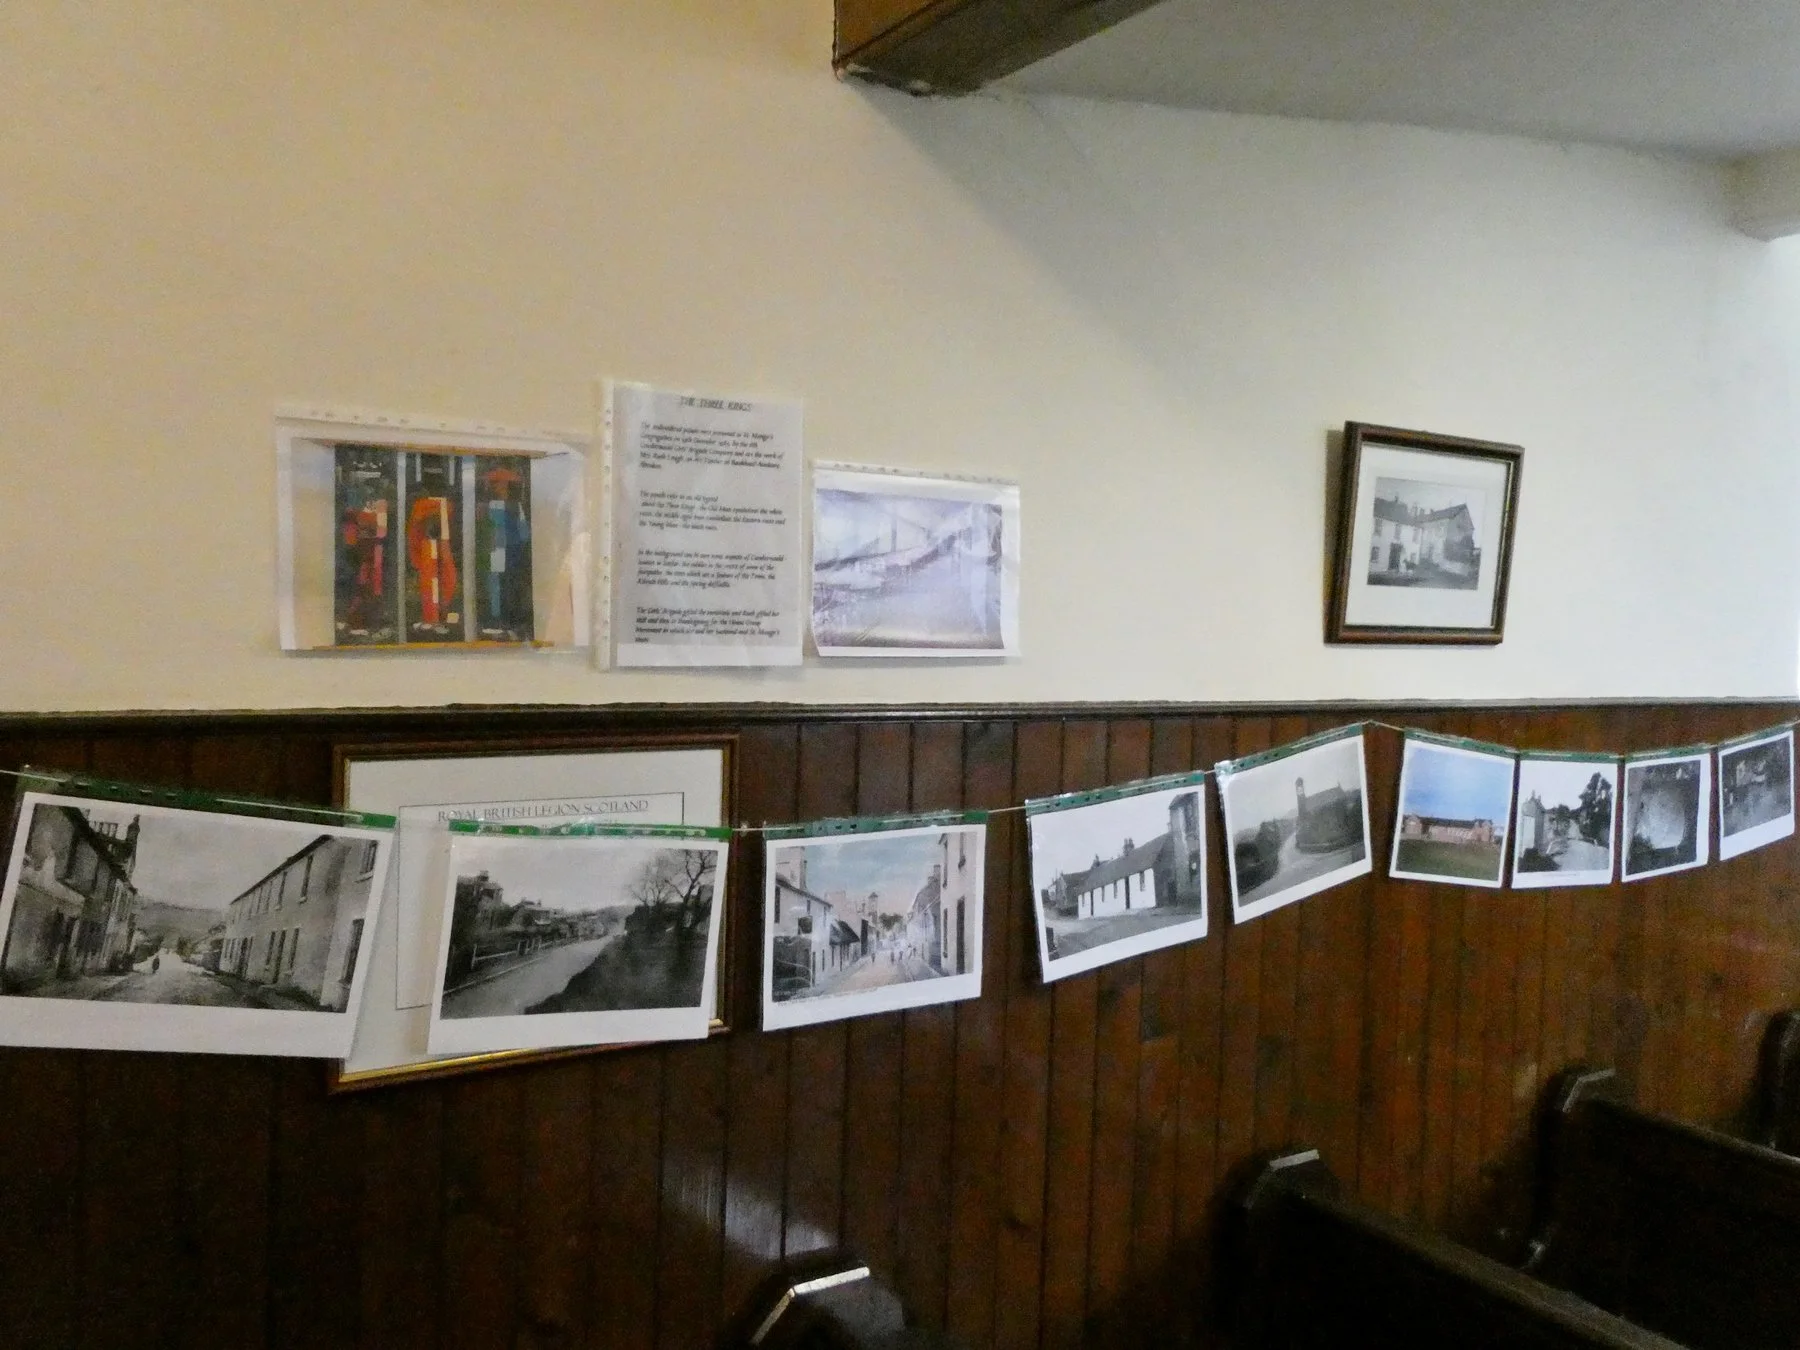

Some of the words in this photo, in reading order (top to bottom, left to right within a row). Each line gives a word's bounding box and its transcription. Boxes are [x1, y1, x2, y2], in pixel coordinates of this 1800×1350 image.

[680, 396, 696, 406] THE
[700, 398, 724, 409] THREE
[728, 401, 752, 411] KINGS
[438, 809, 479, 822] ROYAL
[484, 806, 531, 819] BRITISH
[534, 804, 579, 817] LEGION
[583, 800, 649, 814] SCOTLAND
